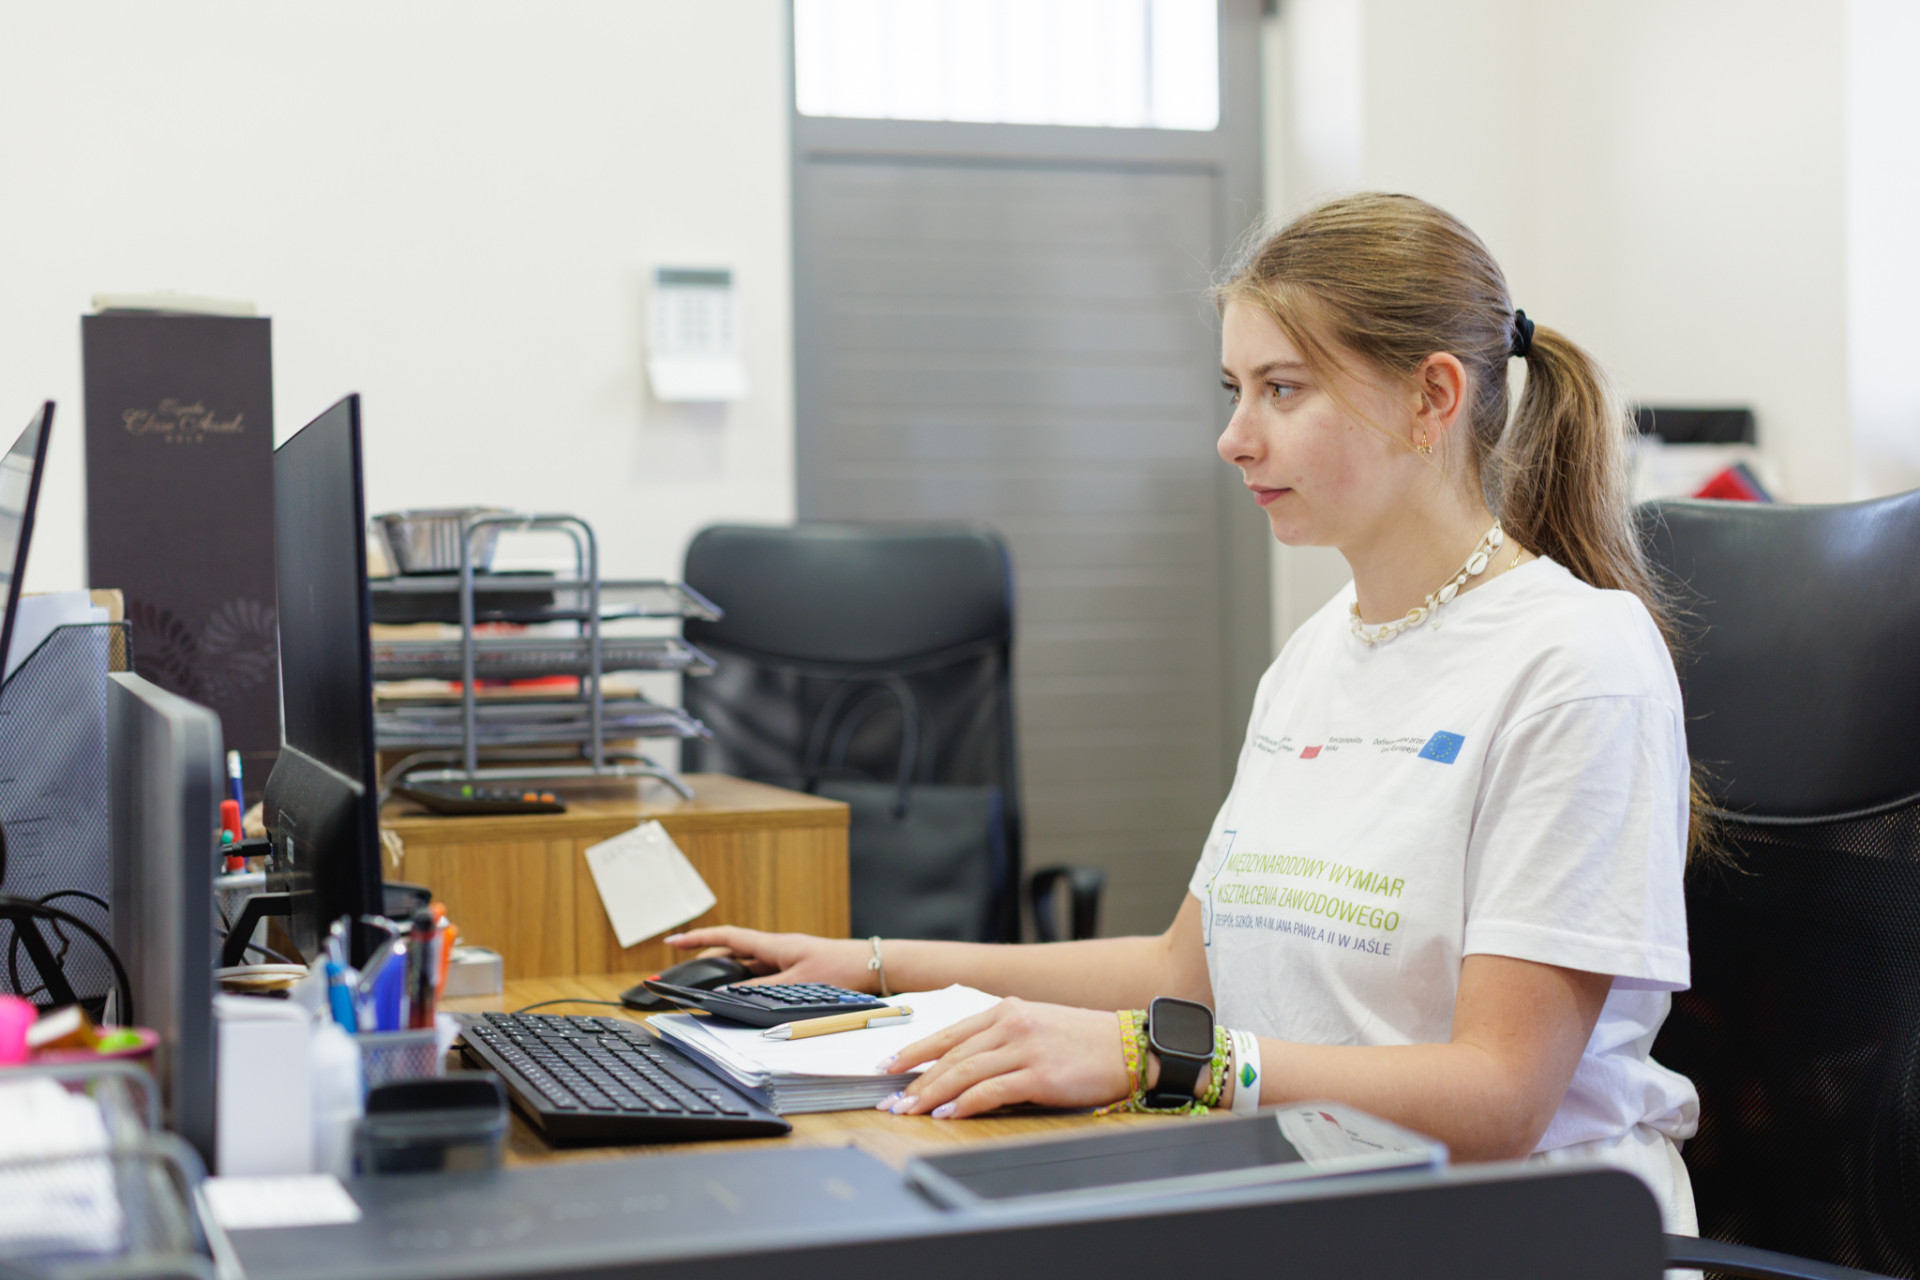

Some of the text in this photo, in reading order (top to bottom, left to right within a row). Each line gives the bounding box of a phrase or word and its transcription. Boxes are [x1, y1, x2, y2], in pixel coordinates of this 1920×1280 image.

[1226, 853, 1405, 899] MIĘDZYNARODOWY WYMIAR
[1217, 884, 1400, 932] KSZTAŁCENIA ZAWODOWEGO
[1275, 919, 1292, 934] JANA
[1293, 921, 1325, 942] PAWŁA
[1327, 931, 1336, 944] II
[1338, 933, 1351, 948] W
[1352, 938, 1393, 956] JAŚLE
